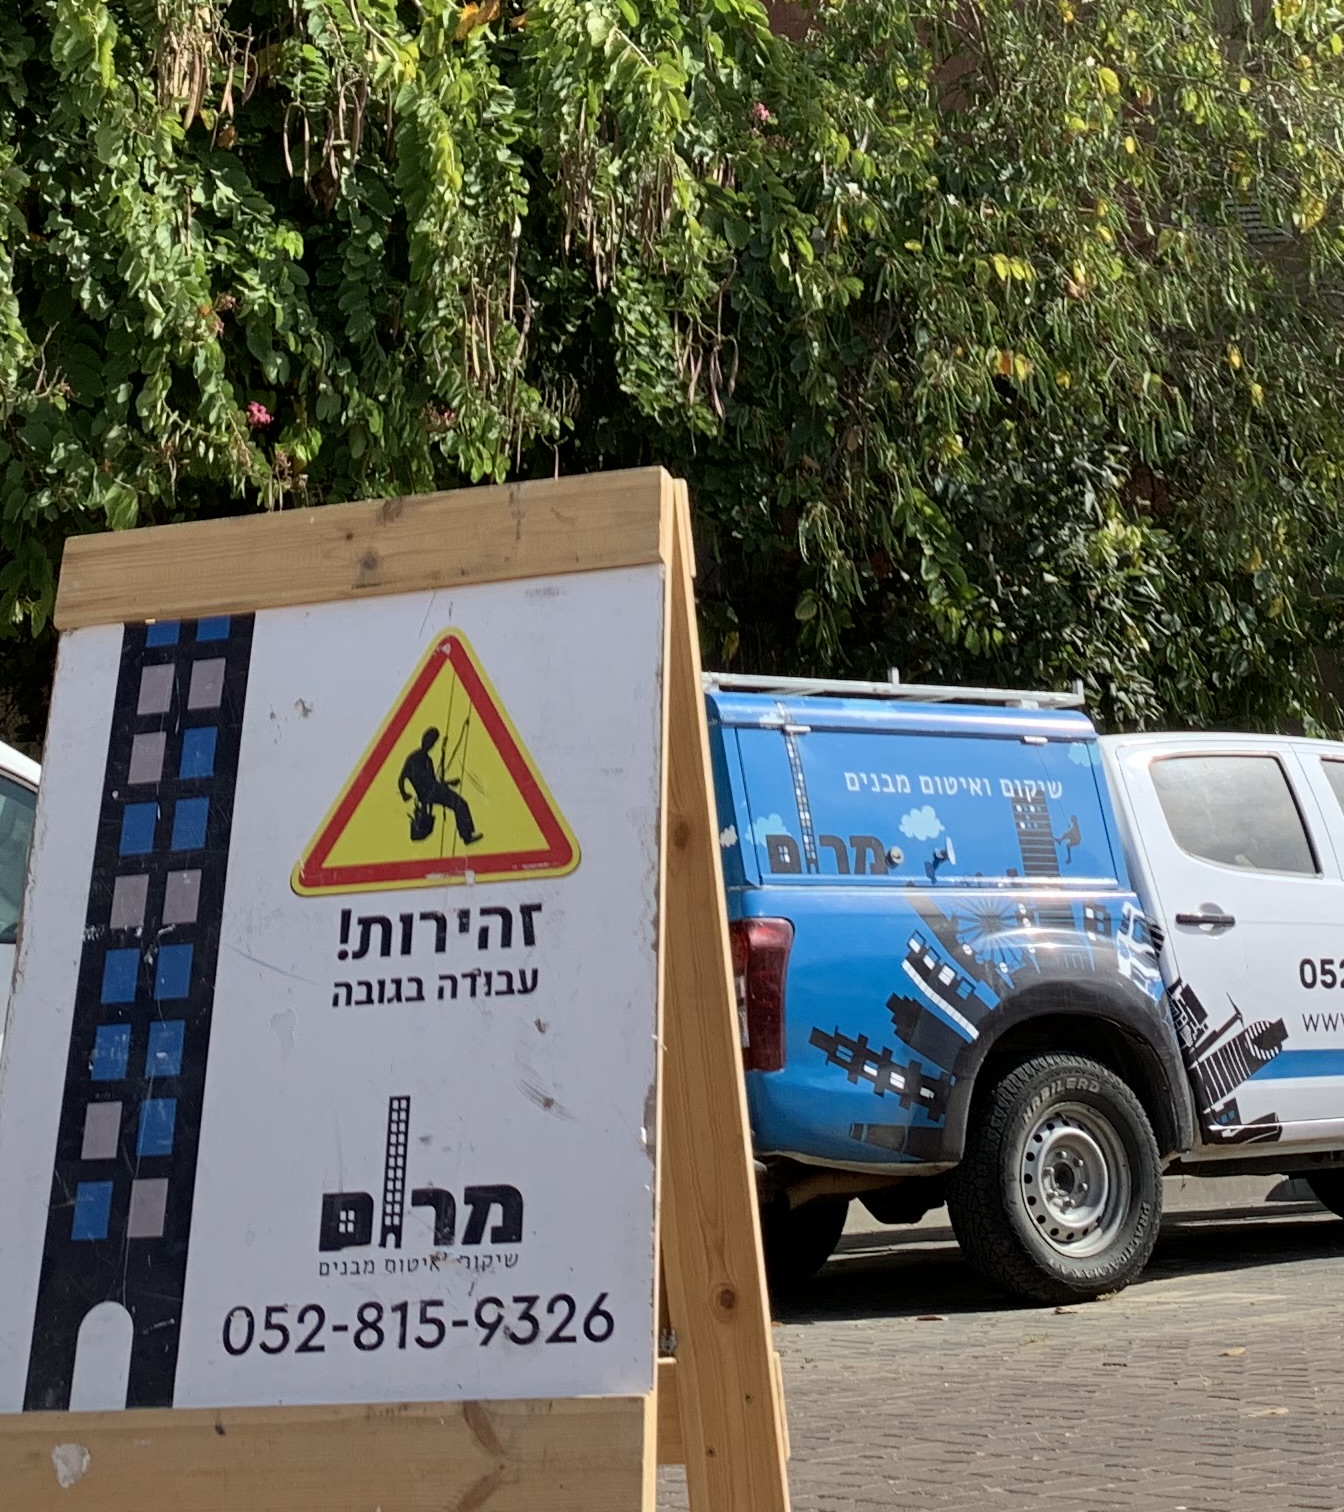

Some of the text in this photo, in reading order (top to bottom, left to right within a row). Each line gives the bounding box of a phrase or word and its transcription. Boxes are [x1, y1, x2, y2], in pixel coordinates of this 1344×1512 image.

[843, 770, 1063, 804] שיקום ואיטום מבנים
[336, 902, 543, 961] זהירות!
[331, 967, 539, 1007] עבודה בגובה
[318, 1094, 525, 1253] מרום
[318, 1258, 376, 1278] מבנים
[221, 1290, 618, 1357] 052-815-9326
